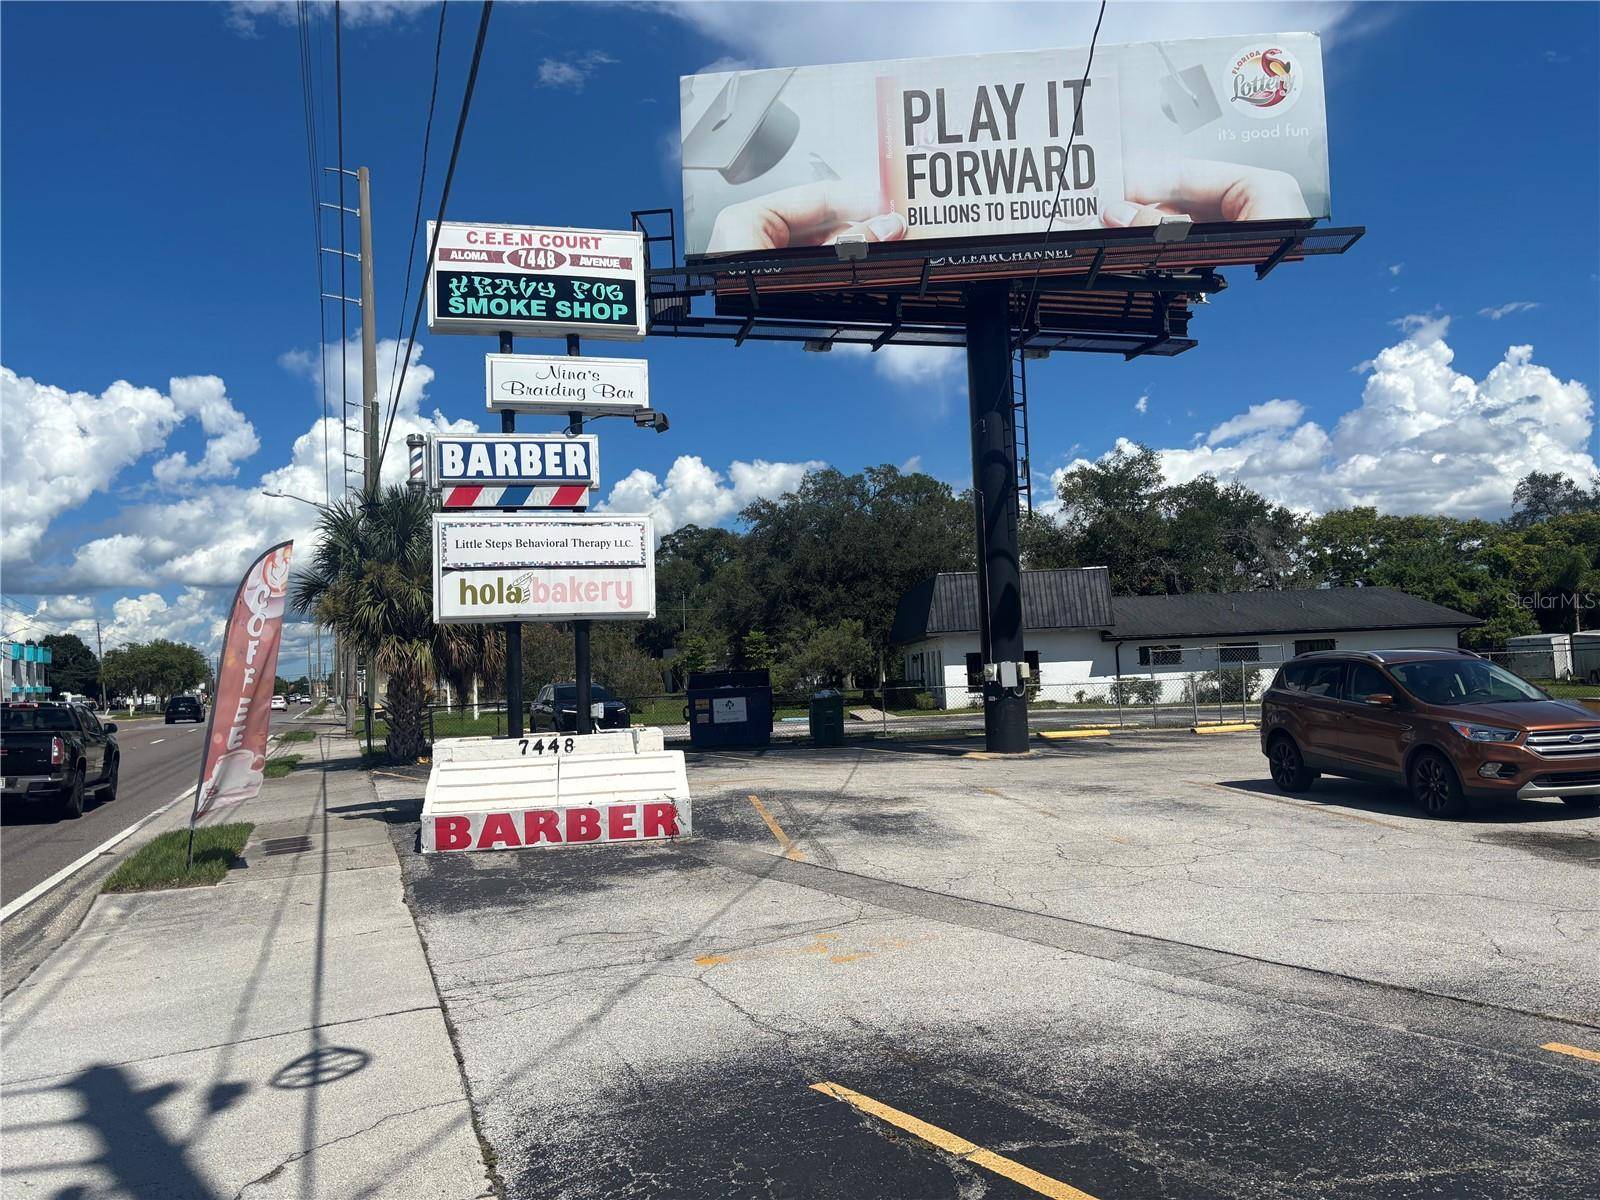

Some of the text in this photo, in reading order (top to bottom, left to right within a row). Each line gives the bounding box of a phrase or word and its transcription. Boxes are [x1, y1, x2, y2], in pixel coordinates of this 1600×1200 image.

[1232, 50, 1261, 75] FLORIDA
[903, 82, 1026, 146] PLAY
[1047, 78, 1092, 138] IT
[1217, 123, 1311, 143] it's good fun
[906, 143, 1096, 200] FORWARD
[907, 203, 981, 226] BILLIONS
[984, 202, 1004, 221] TO
[1010, 196, 1098, 220] EDUCATION
[466, 230, 602, 250] C.E.E.N COURT
[450, 251, 488, 262] ALOMA
[518, 249, 556, 268] 7448
[579, 256, 620, 269] AVENUE
[570, 280, 624, 301] FOG
[448, 298, 629, 321] SMOKE SHOP
[535, 365, 600, 381] Nina's
[501, 381, 635, 401] Braiding Bar
[442, 443, 587, 477] BARBER
[455, 538, 483, 549] Little
[485, 538, 513, 551] Steps
[515, 538, 569, 549] Behavioral
[571, 537, 611, 550] Therapy
[459, 575, 633, 609] hola bakery
[518, 738, 575, 755] 7448
[434, 802, 680, 851] BARBER
